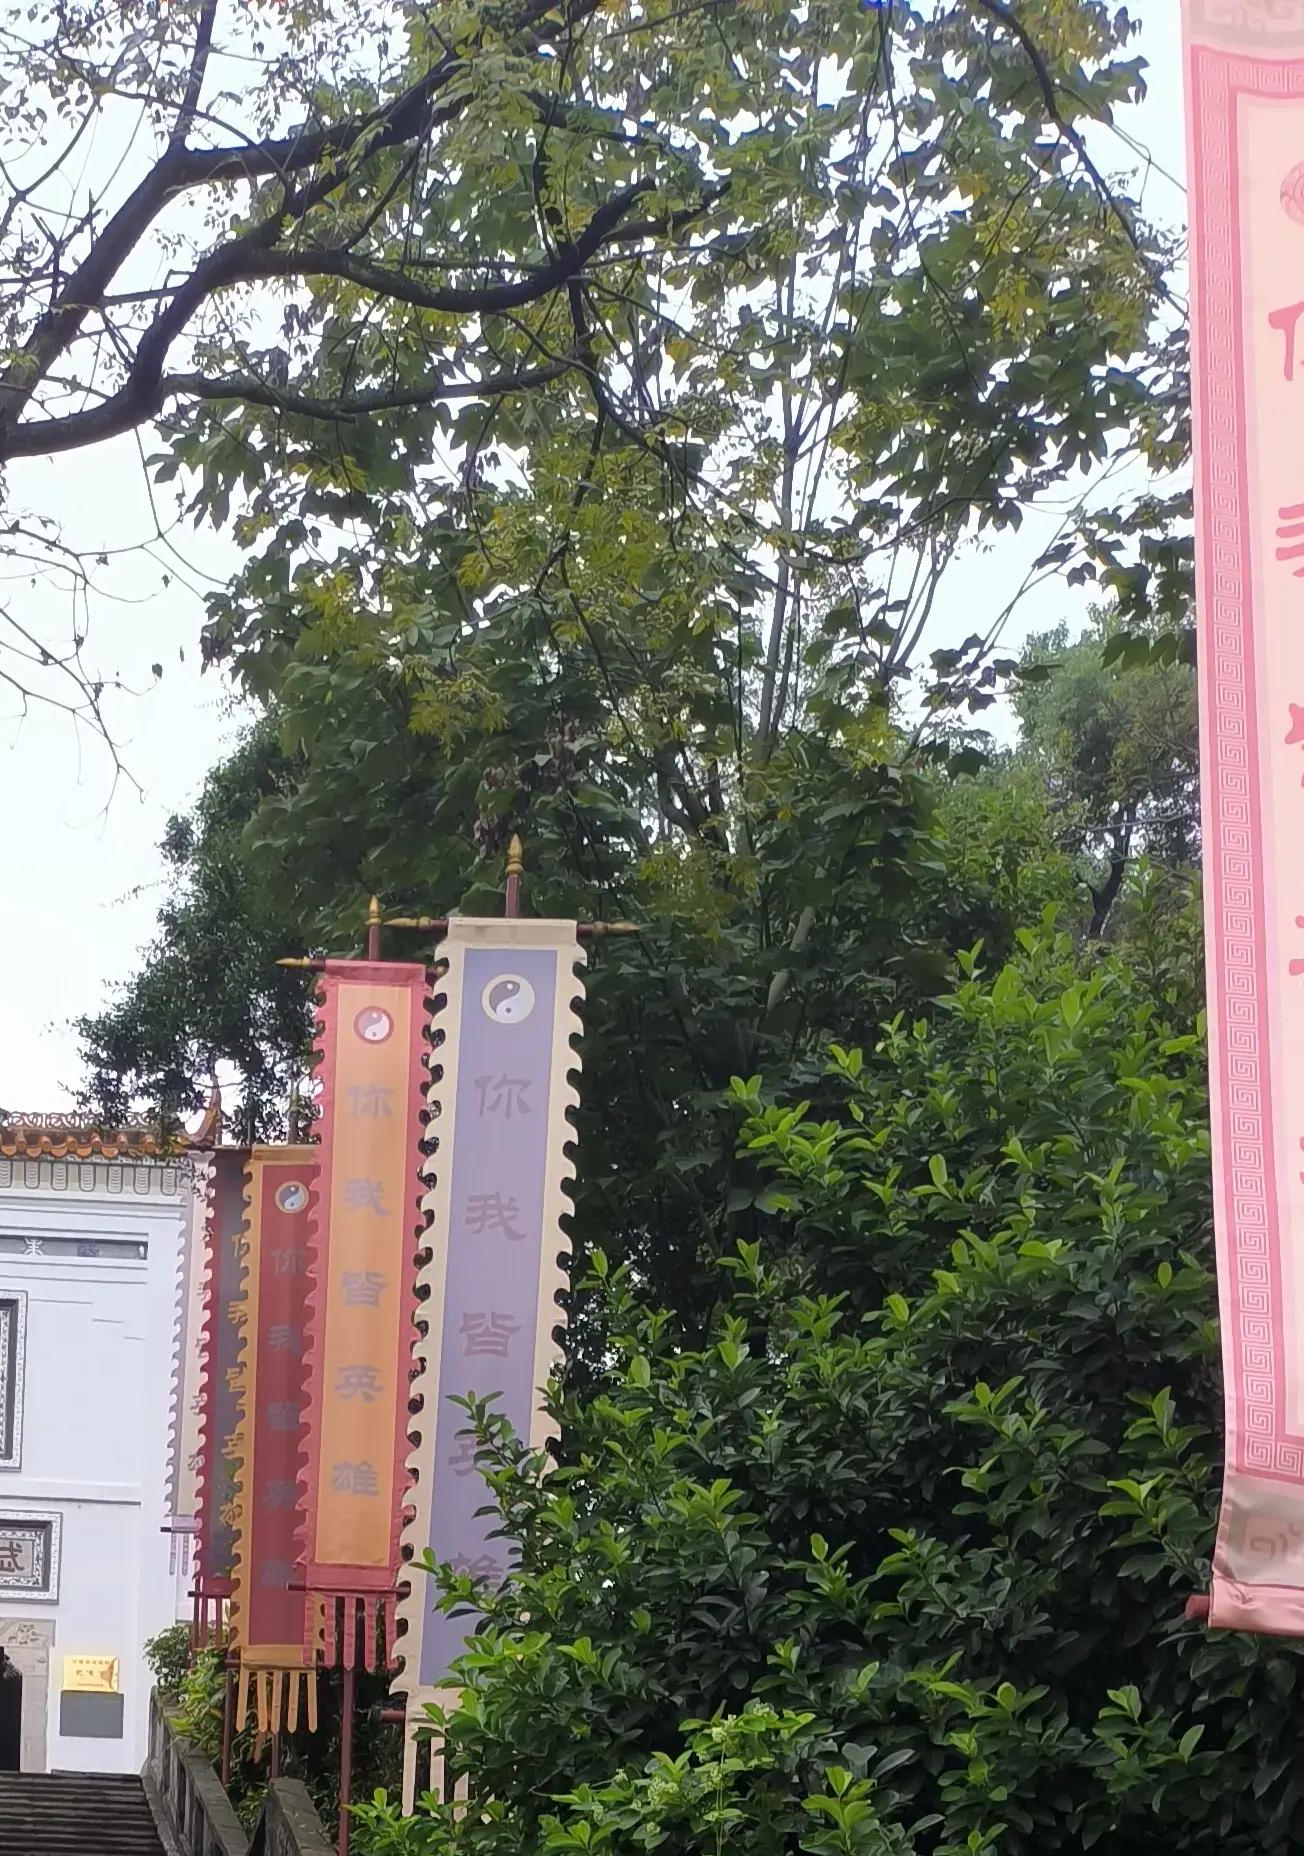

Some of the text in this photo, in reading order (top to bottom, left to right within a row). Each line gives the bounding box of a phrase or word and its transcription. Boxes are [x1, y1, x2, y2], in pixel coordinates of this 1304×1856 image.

[330, 1082, 394, 1498] 你我皆英雄
